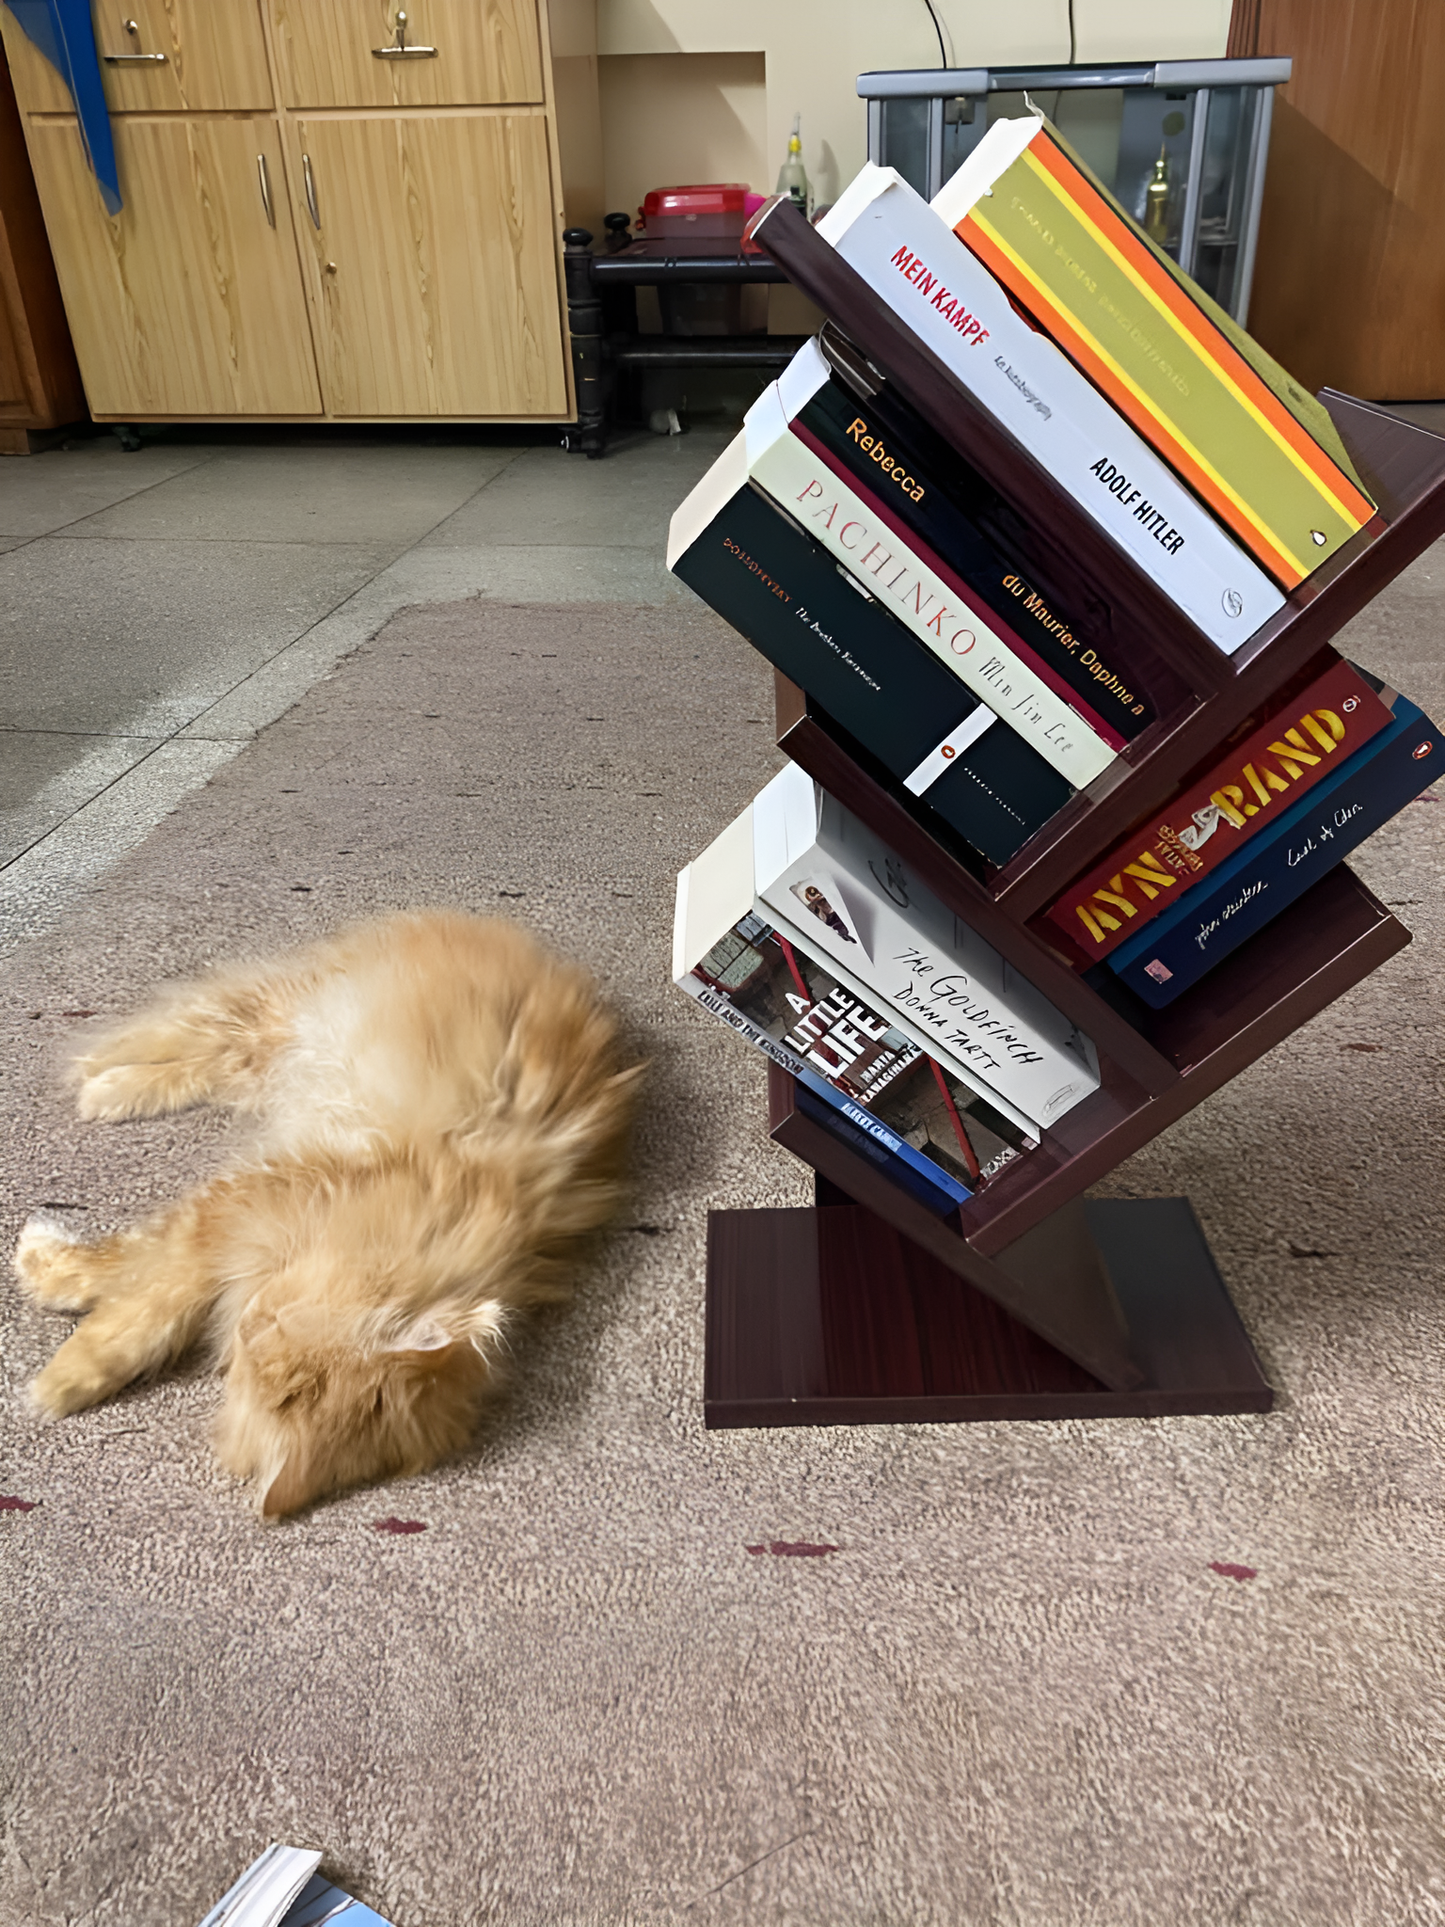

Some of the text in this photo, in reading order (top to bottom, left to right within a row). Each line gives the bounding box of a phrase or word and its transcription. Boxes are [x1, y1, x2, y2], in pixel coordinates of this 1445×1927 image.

[890, 245, 990, 346] MEIN KAMPF
[845, 417, 926, 502] Rebecca
[1089, 457, 1185, 555] ADOLF HITLER
[796, 480, 976, 656] PACHINKO
[1002, 574, 1026, 597] du
[1023, 592, 1081, 655] Maurier,
[1080, 649, 1134, 704] Daphne
[979, 656, 1074, 752] Min Jin Lee
[1075, 709, 1346, 943] AYN RAND
[785, 992, 810, 1015] A
[892, 947, 934, 977] The
[784, 988, 855, 1055] LITTLE
[806, 1005, 889, 1079] LIFE
[892, 980, 1002, 1069] DONNA TARTT
[860, 1050, 896, 1083] HANYA
